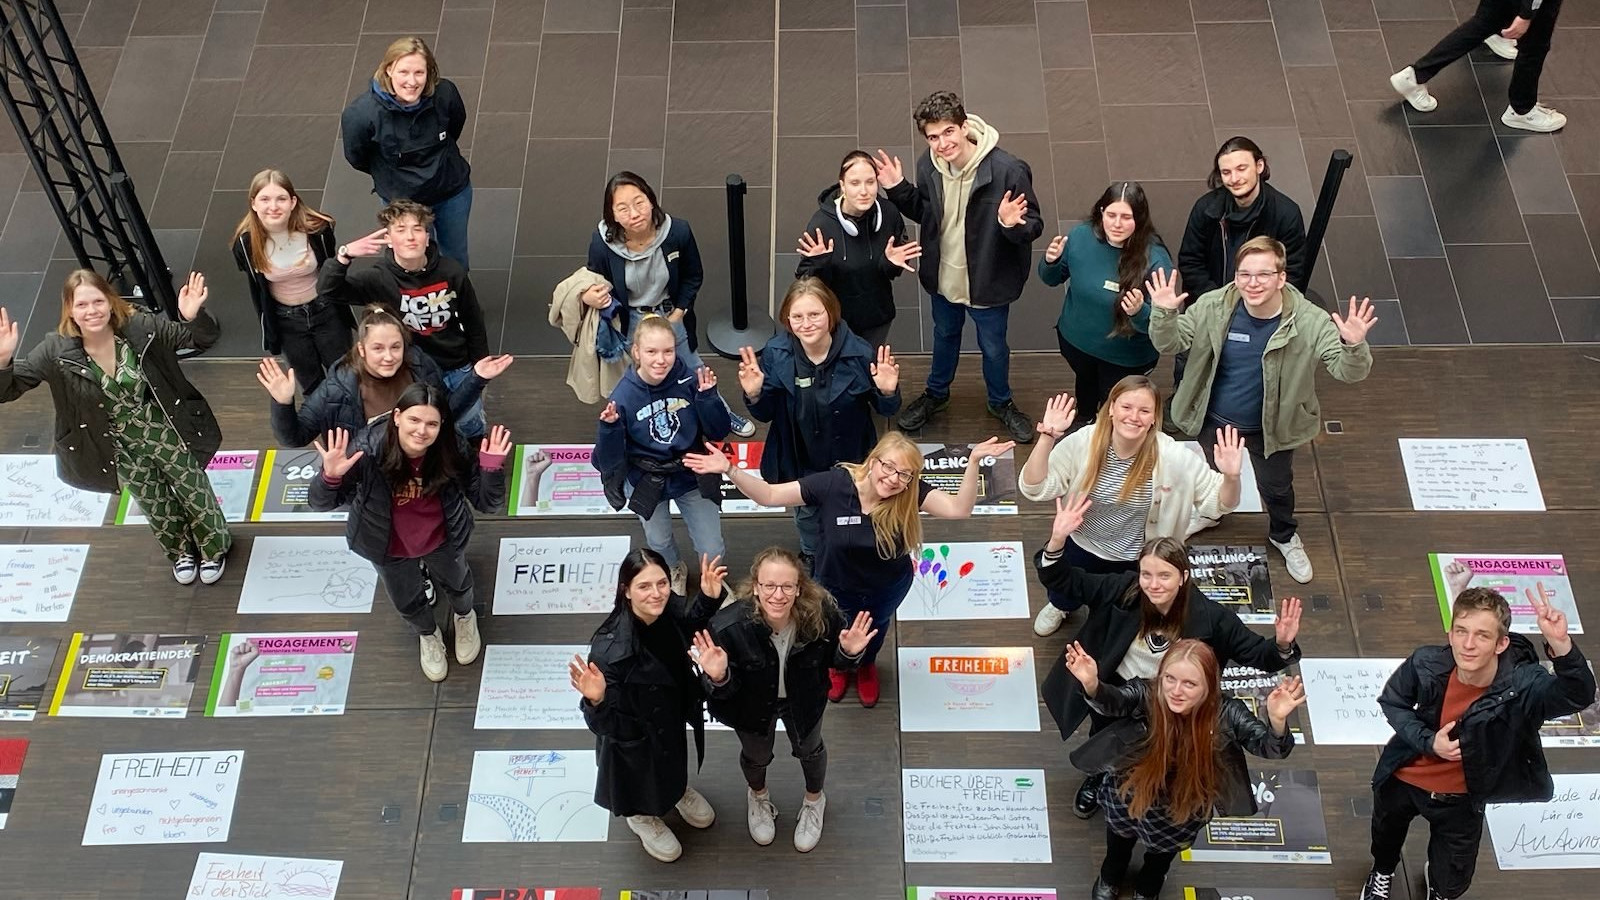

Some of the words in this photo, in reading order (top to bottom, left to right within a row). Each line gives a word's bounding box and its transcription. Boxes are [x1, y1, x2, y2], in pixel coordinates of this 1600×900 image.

[514, 562, 620, 584] FREIHEIT
[1468, 560, 1551, 570] ENGAGEMENT
[258, 638, 343, 648] ENGAGEMENT
[80, 649, 192, 665] DEMOKRATIEINDEX
[109, 757, 211, 780] FREIHEIT
[963, 788, 1026, 803] FREIHEIT
[206, 861, 266, 880] Freiheit
